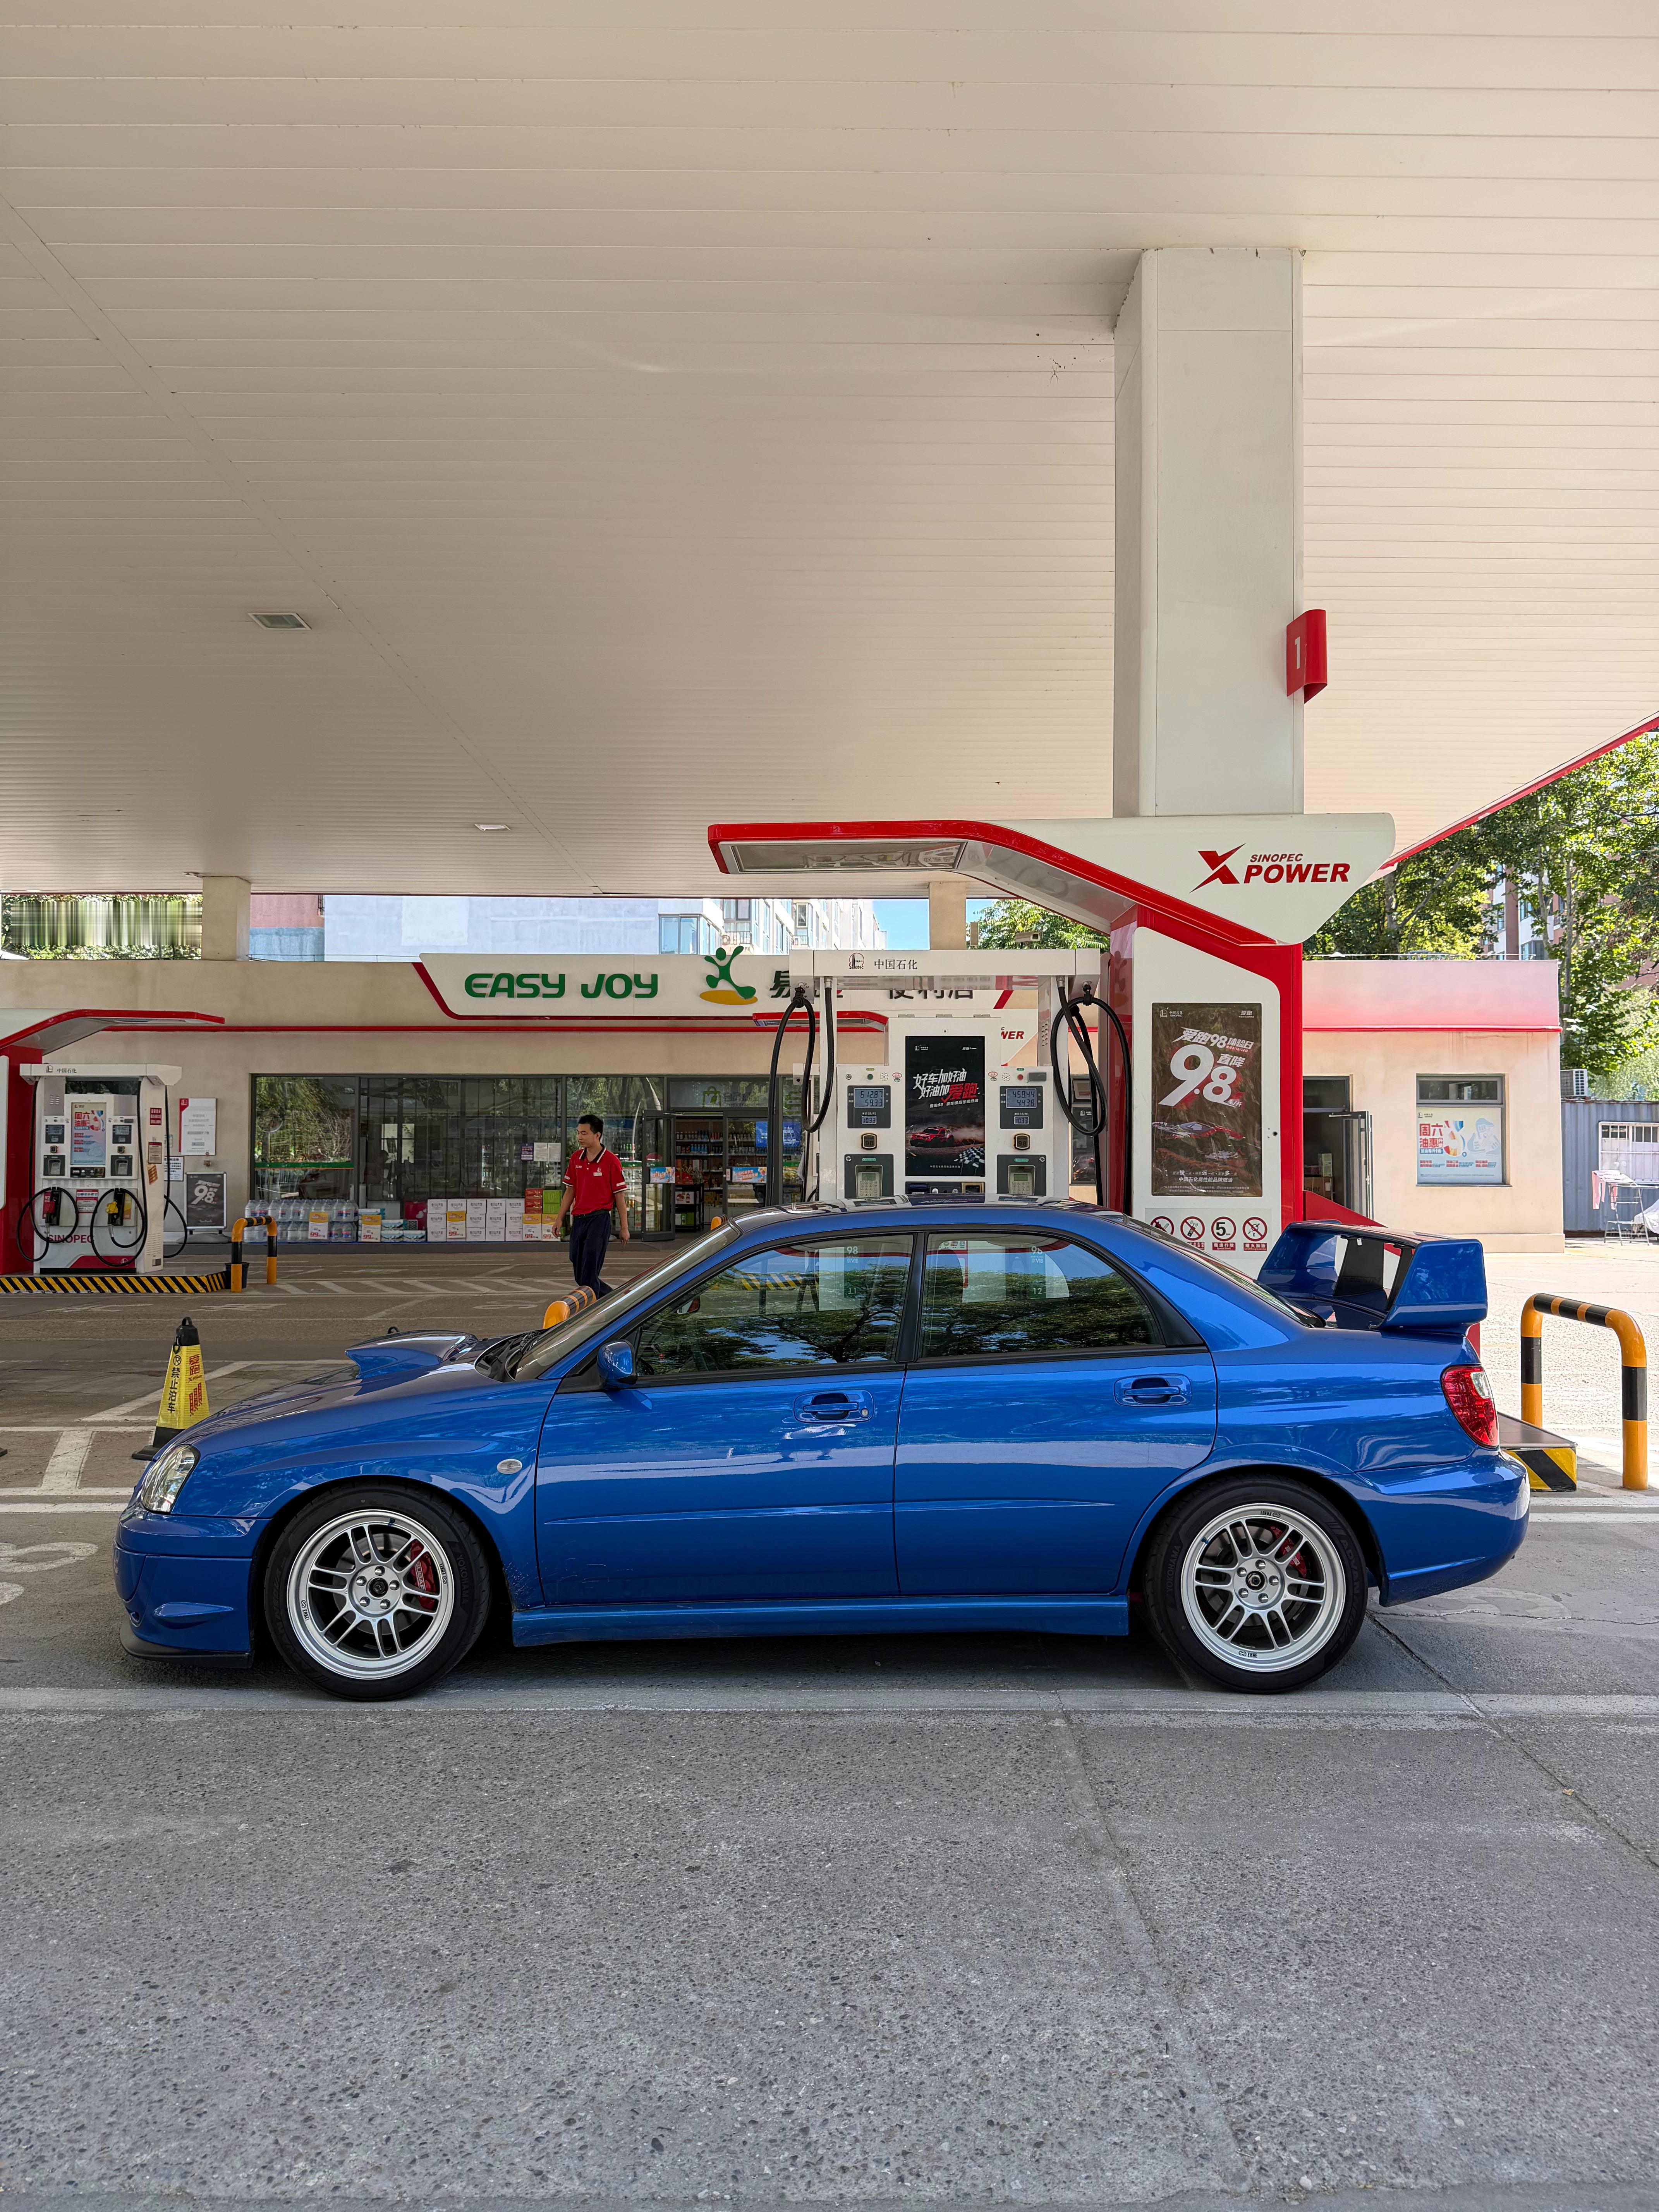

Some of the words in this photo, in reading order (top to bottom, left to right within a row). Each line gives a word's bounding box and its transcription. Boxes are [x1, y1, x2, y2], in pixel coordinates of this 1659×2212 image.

[1295, 636, 1300, 670] 1
[1250, 853, 1304, 862] SINOPEC
[1243, 863, 1350, 884] POWER
[874, 959, 917, 970] 中国石化
[465, 973, 565, 998] EASY
[581, 973, 658, 998] JOY
[1217, 1053, 1246, 1068] 直降
[913, 1068, 967, 1089] 好车加好油
[918, 1083, 977, 1103] 好油加爱跑
[1419, 1123, 1443, 1136] 周六
[1216, 1222, 1226, 1236] 5
[847, 1246, 858, 1255] 98
[457, 1554, 469, 1604] YOKOHAMA
[1166, 1546, 1182, 1592] YOKOHAMA
